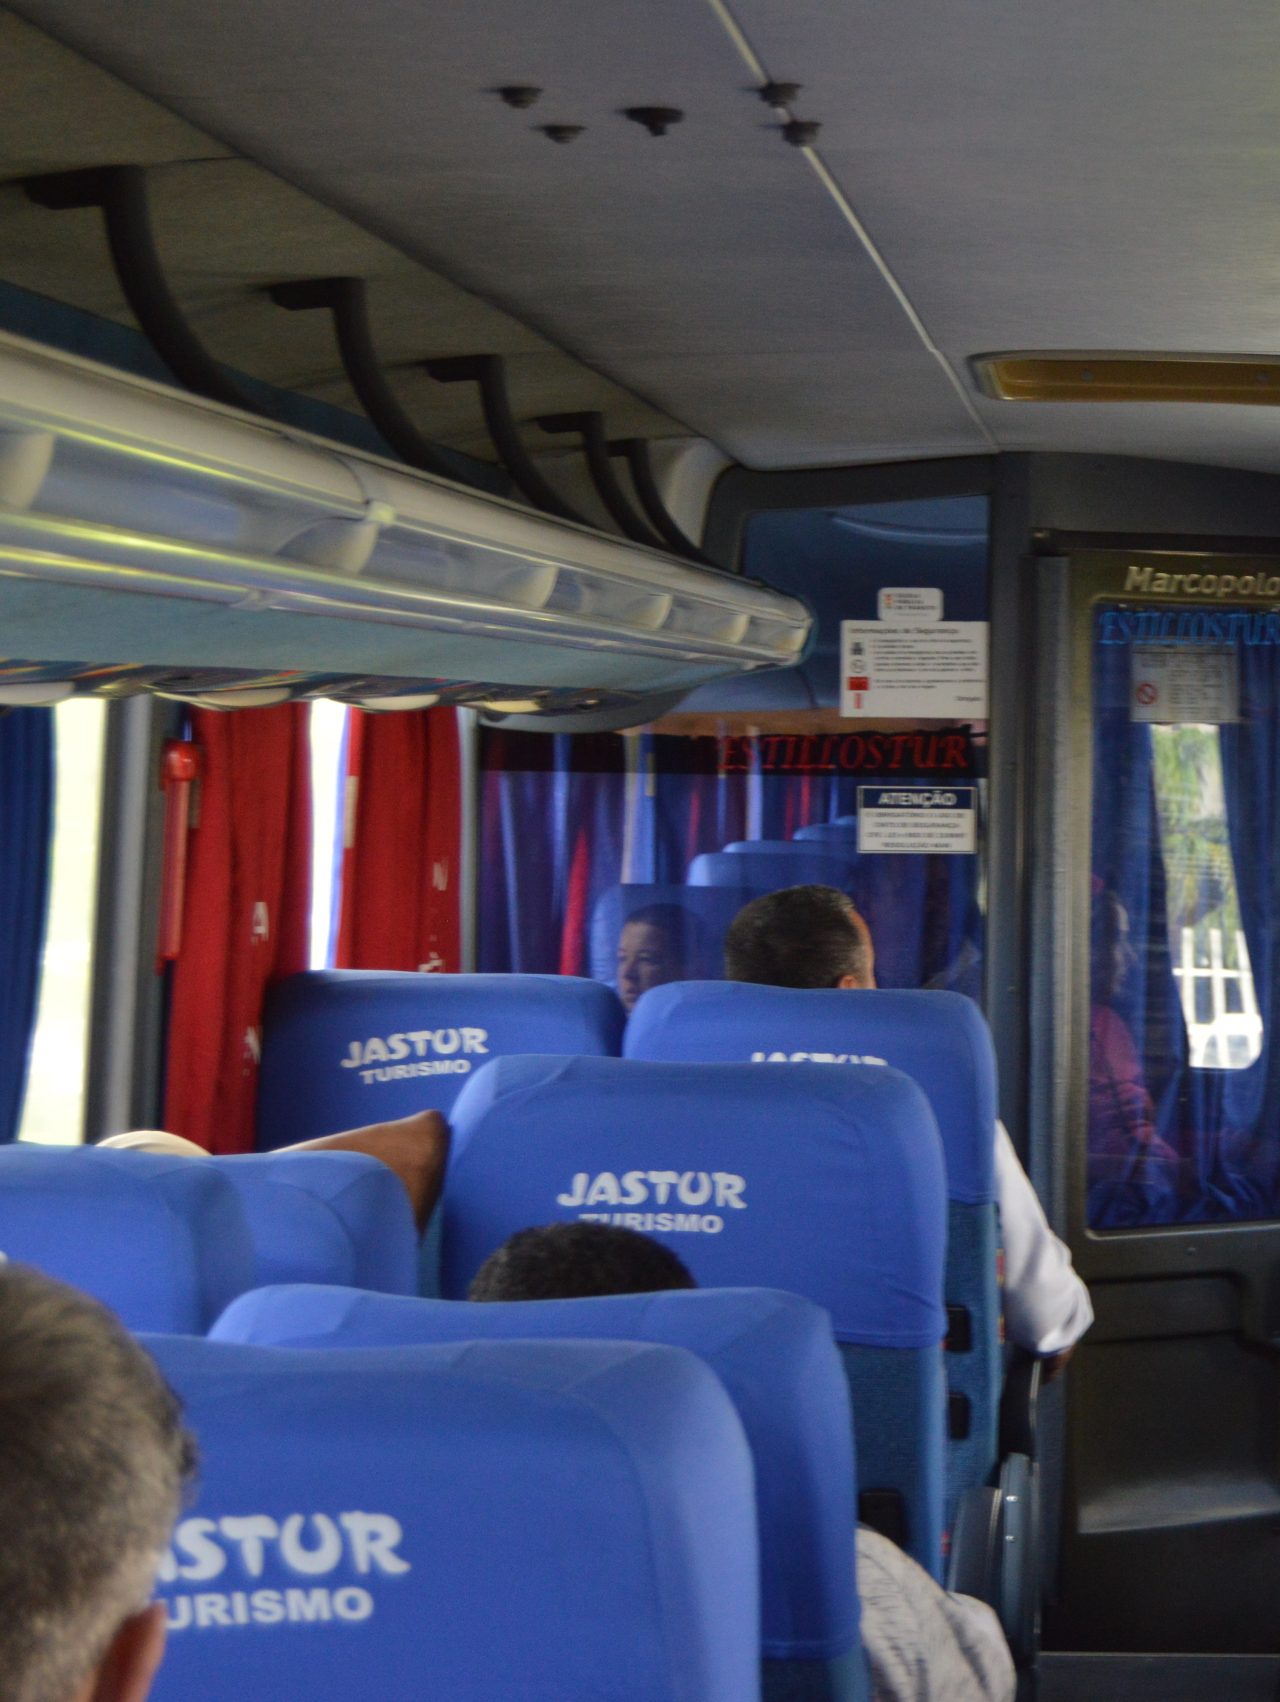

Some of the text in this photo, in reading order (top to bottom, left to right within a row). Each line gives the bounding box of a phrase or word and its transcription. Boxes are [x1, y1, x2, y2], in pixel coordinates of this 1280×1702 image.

[718, 735, 969, 769] ESTILLOSTUR
[878, 790, 958, 808] ATENÇÃO
[340, 1027, 489, 1068] JASTUR
[359, 1059, 471, 1084] TURISMO
[556, 1170, 748, 1209] JASTUR
[163, 1586, 373, 1630] URISMO
